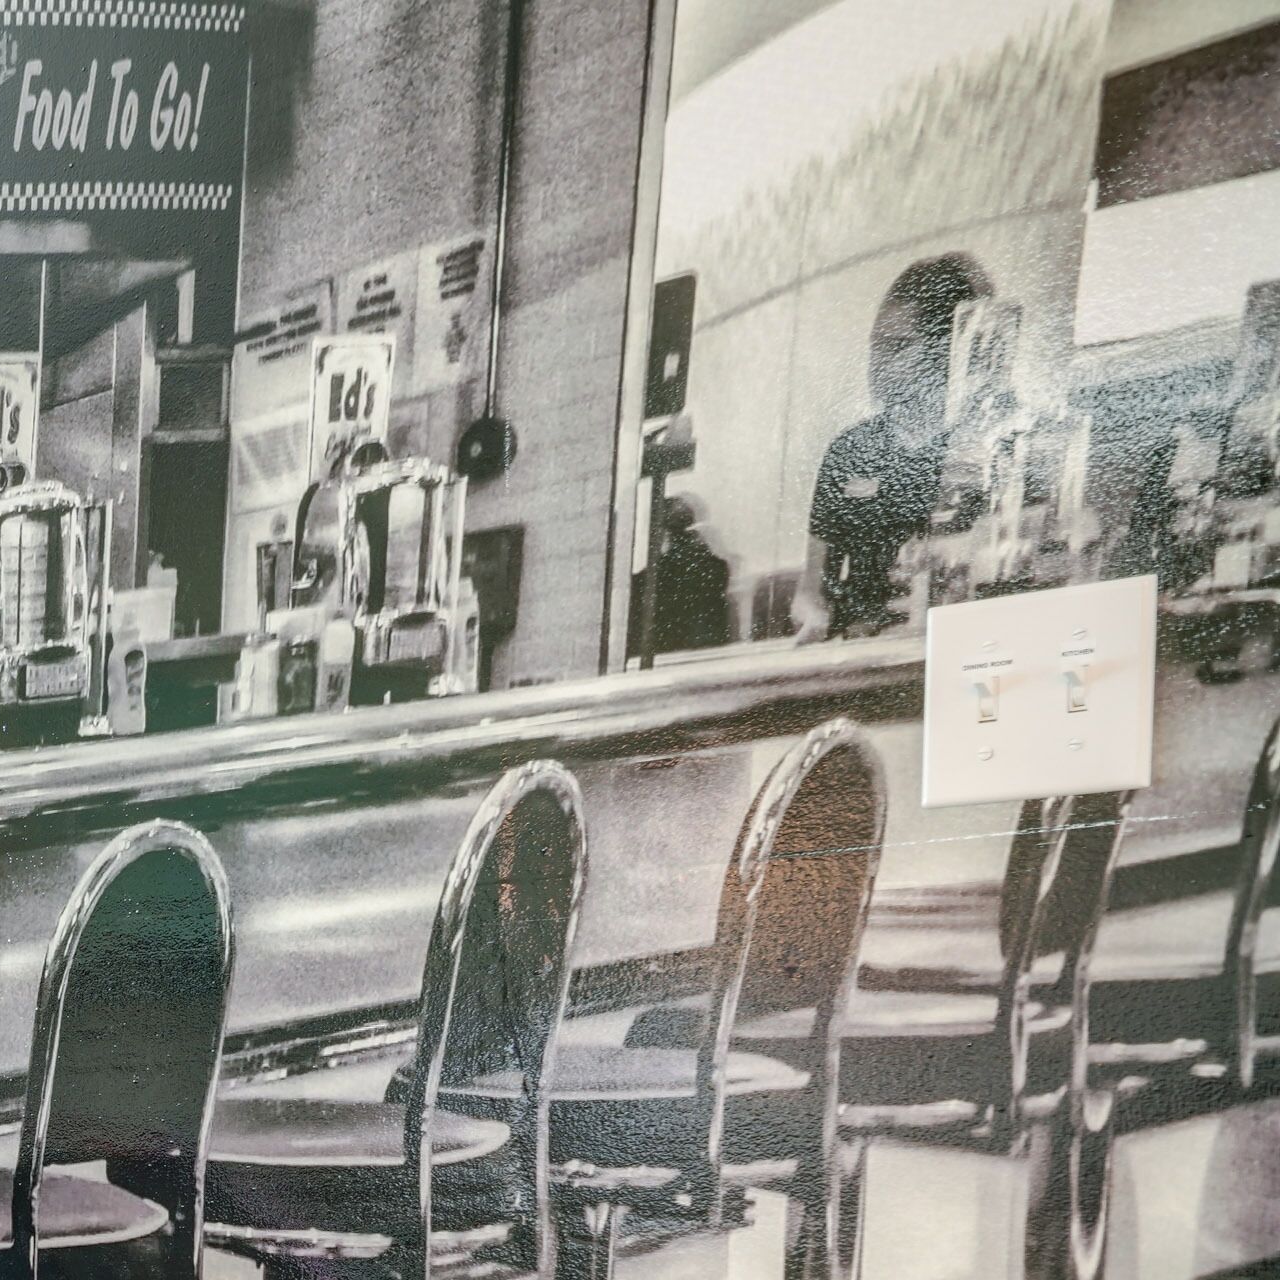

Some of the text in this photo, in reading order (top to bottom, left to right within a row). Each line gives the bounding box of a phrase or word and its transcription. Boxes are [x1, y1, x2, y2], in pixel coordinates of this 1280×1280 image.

[13, 58, 210, 152] Food To Go!
